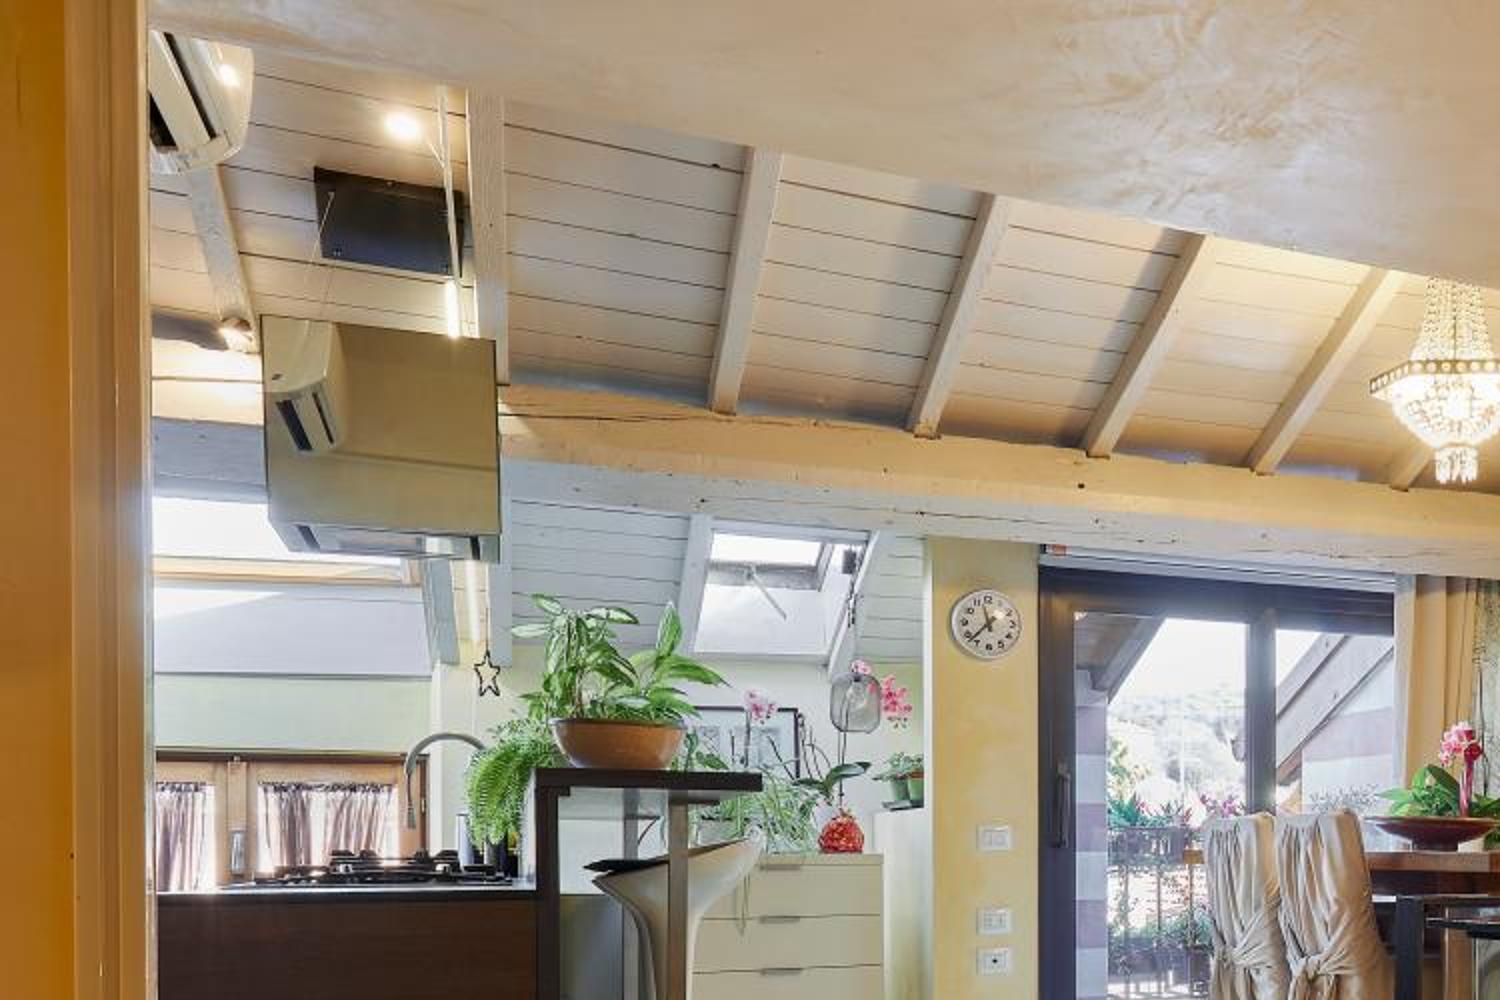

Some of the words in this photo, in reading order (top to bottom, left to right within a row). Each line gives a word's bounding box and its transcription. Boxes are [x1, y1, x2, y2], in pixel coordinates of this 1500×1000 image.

[983, 595, 993, 604] 12
[1006, 608, 1013, 616] 2
[961, 618, 969, 626] 9
[1009, 620, 1016, 628] 3
[997, 641, 1005, 649] 5
